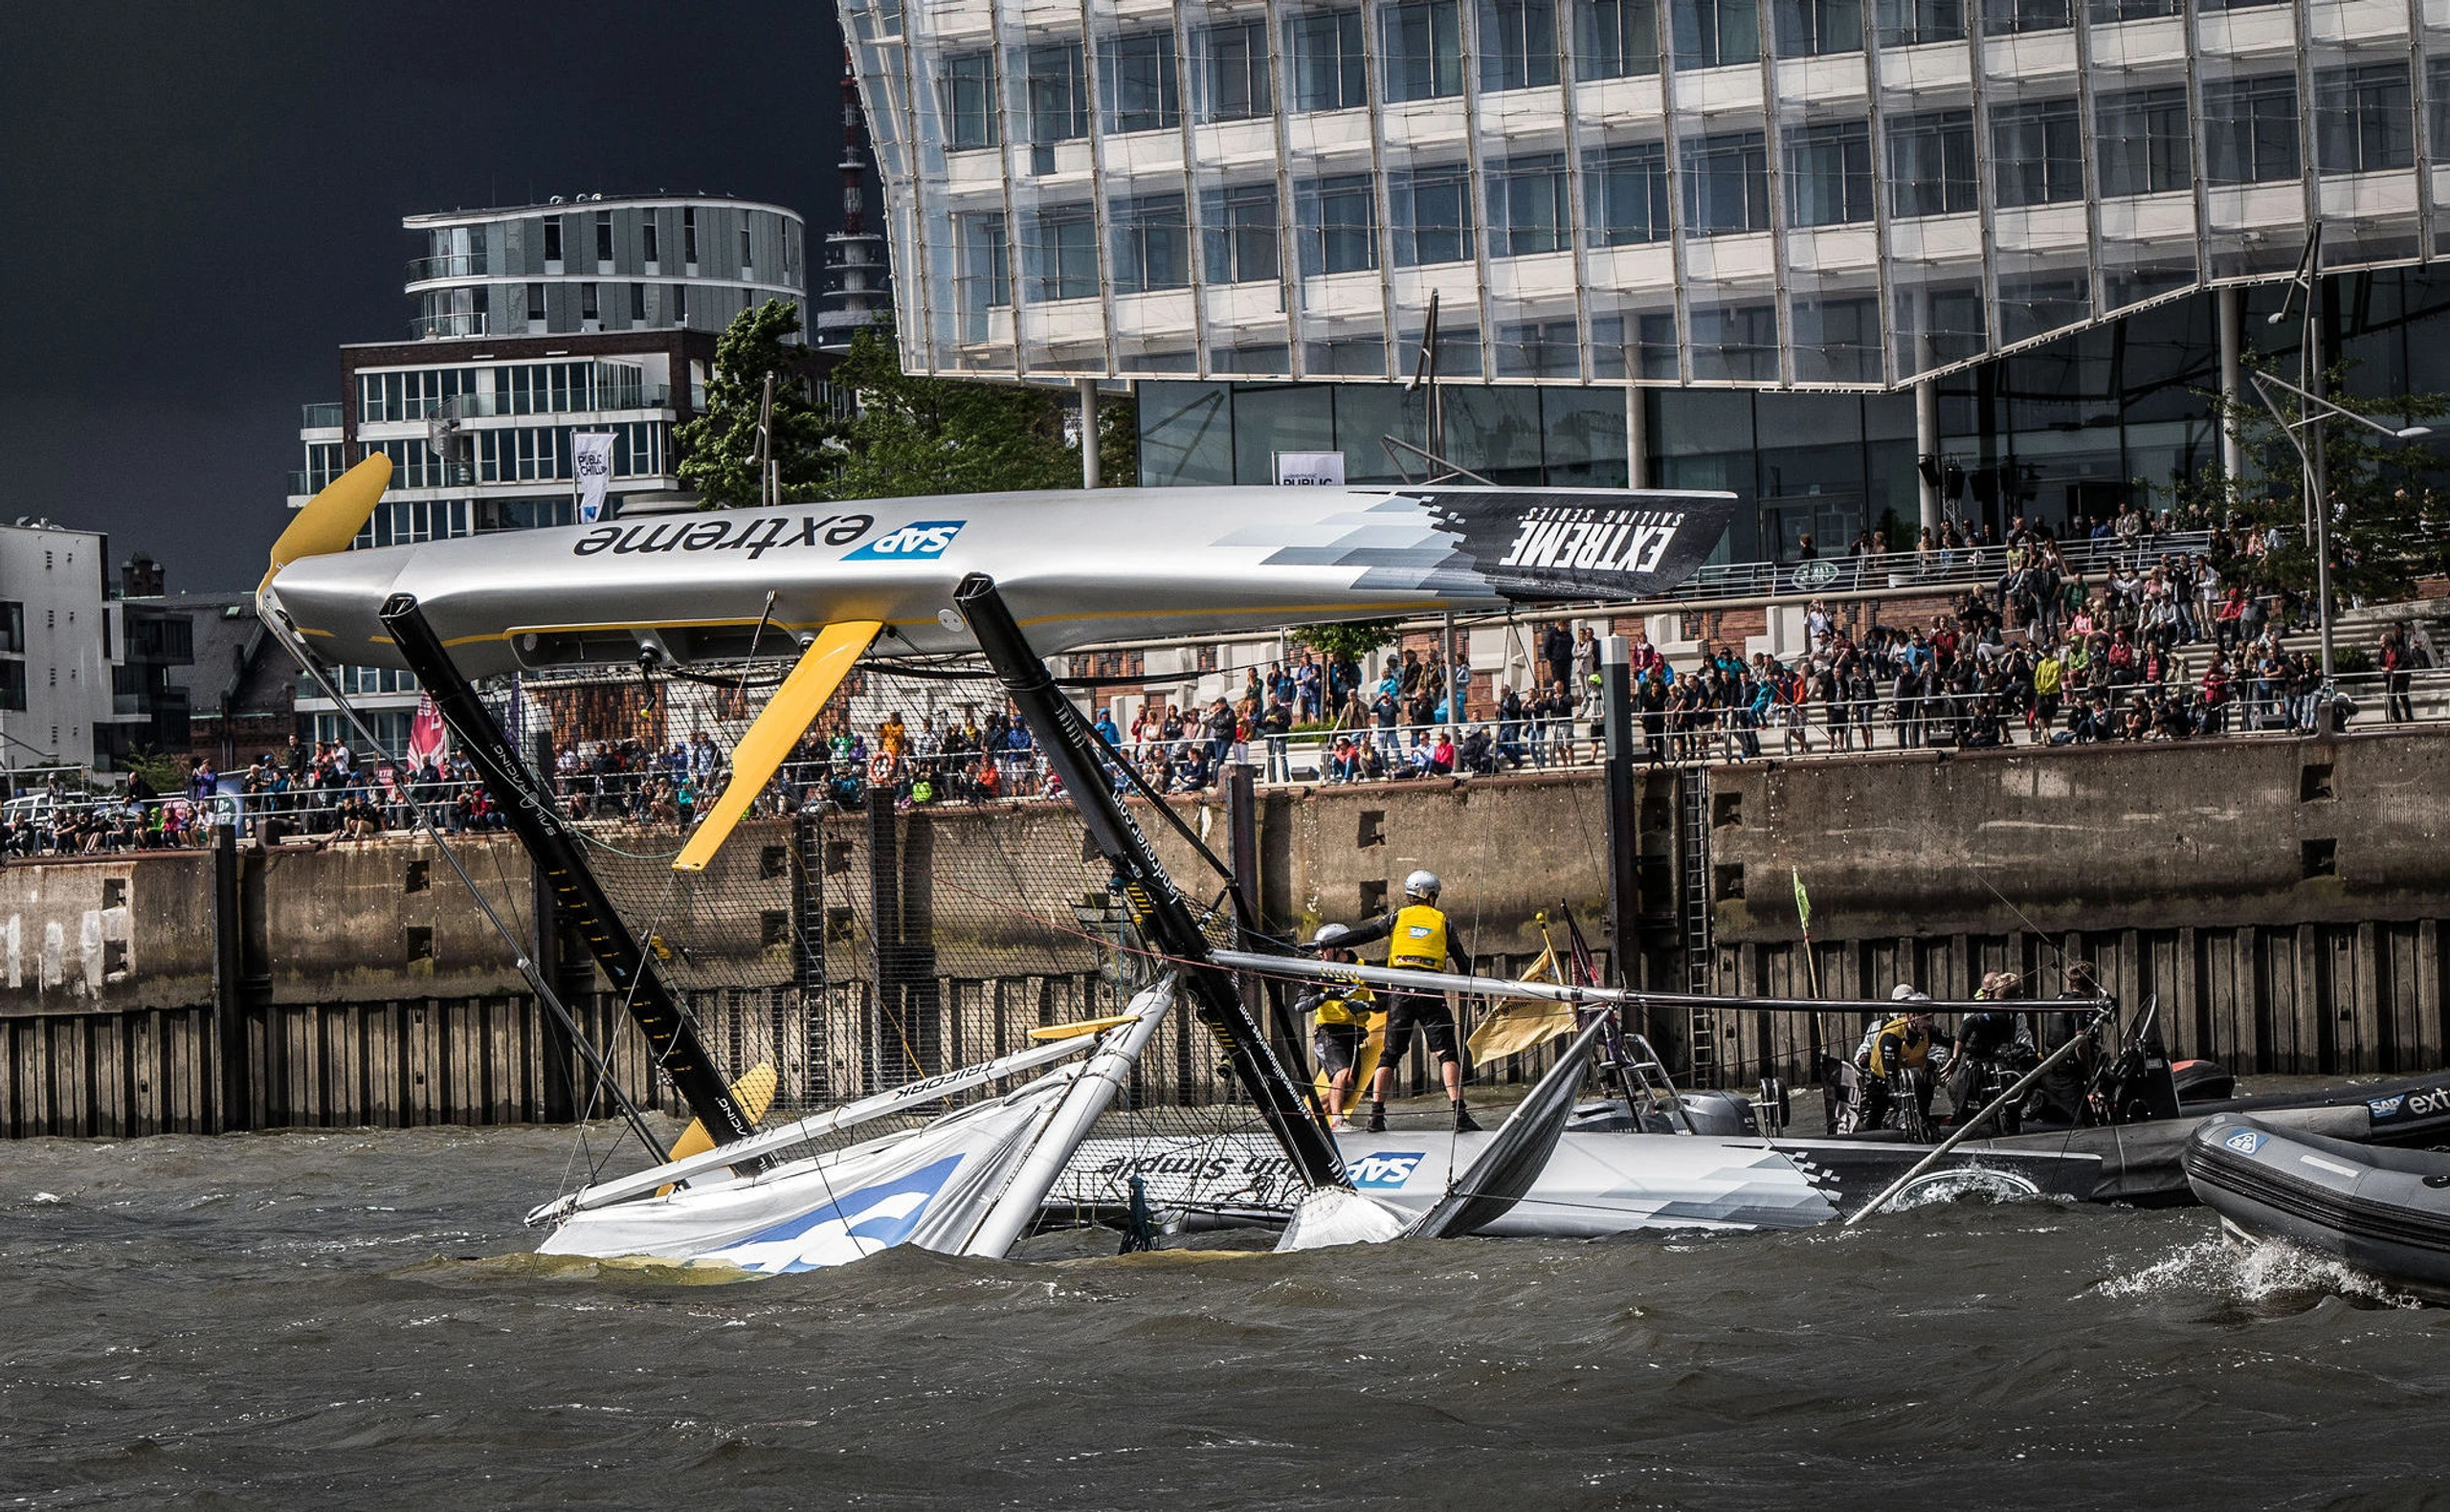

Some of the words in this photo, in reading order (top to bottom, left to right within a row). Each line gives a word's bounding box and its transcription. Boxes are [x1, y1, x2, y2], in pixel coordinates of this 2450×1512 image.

[1526, 506, 1595, 523] SERIES
[1603, 509, 1684, 526] SAILING
[572, 514, 875, 560] extreme
[873, 526, 959, 554] SAP
[1498, 520, 1677, 572] EXTREME
[493, 744, 529, 795] RACING
[535, 809, 557, 837] SAIL
[1111, 790, 1180, 905] landrover.com
[894, 1060, 995, 1101] TRIFORK
[2371, 1098, 2401, 1114] SAP
[2408, 1087, 2450, 1114] ext
[718, 1098, 748, 1137] ACING
[1347, 1156, 1414, 1183] SAP
